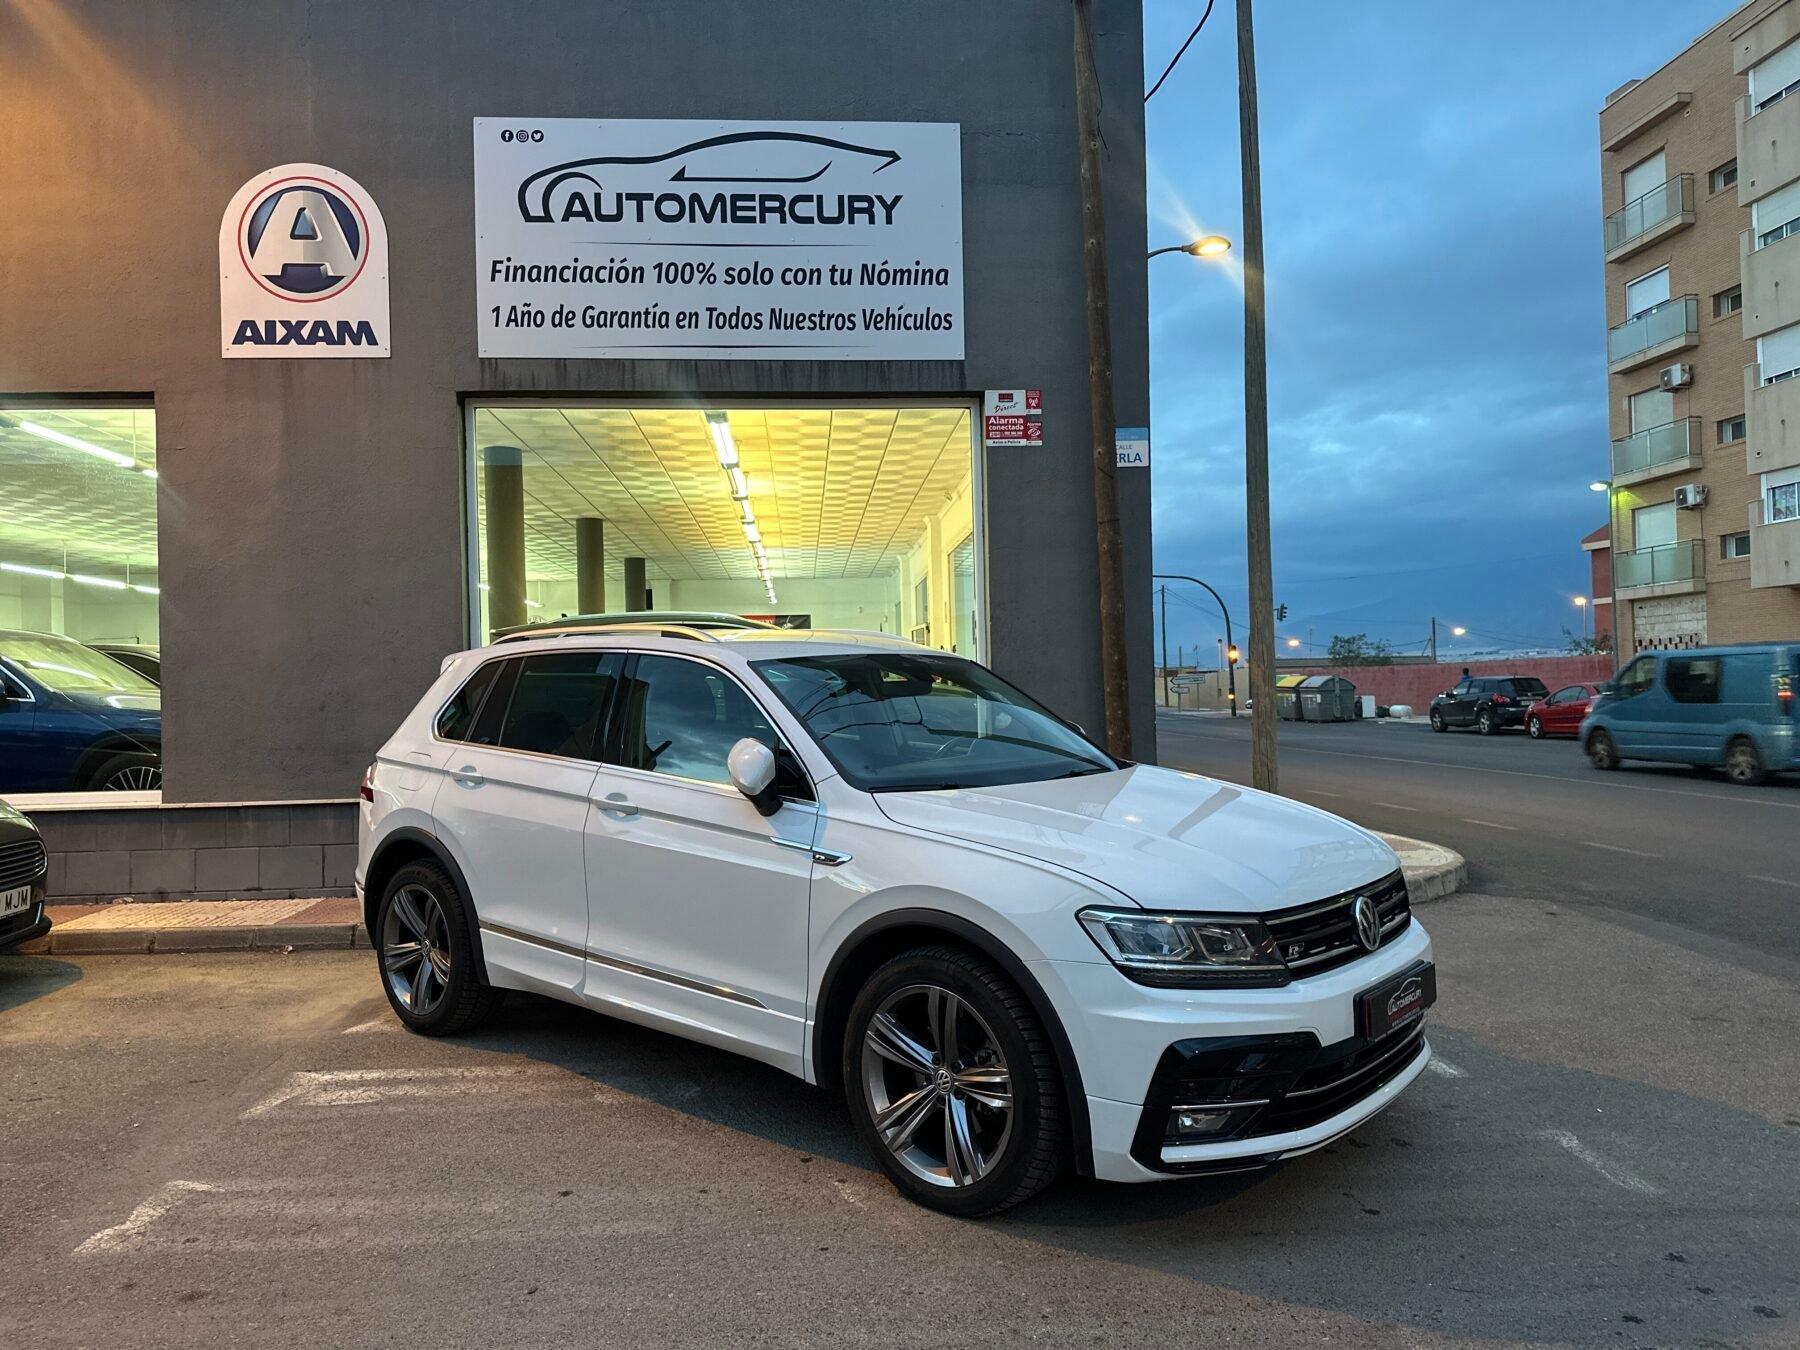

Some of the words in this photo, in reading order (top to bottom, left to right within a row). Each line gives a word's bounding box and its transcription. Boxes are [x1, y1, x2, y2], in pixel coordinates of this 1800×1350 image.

[561, 192, 904, 225] AUTOMERCURY
[490, 256, 645, 283] Financiación
[653, 261, 717, 285] 100%
[723, 261, 774, 286] solo
[780, 265, 822, 286] con
[829, 264, 852, 286] tu
[860, 260, 949, 286] Nómina
[491, 306, 501, 328] 1
[505, 302, 545, 328] Año
[551, 304, 576, 328] de
[581, 302, 670, 329] Garantía
[675, 311, 699, 329] en
[705, 305, 763, 330] Todos
[769, 307, 856, 331] Nuestros
[862, 304, 952, 331] Vehículos
[232, 320, 379, 346] AIXAM
[989, 416, 1024, 425] Alarma
[1117, 452, 1142, 463] RLA
[5, 889, 28, 911] MJM
